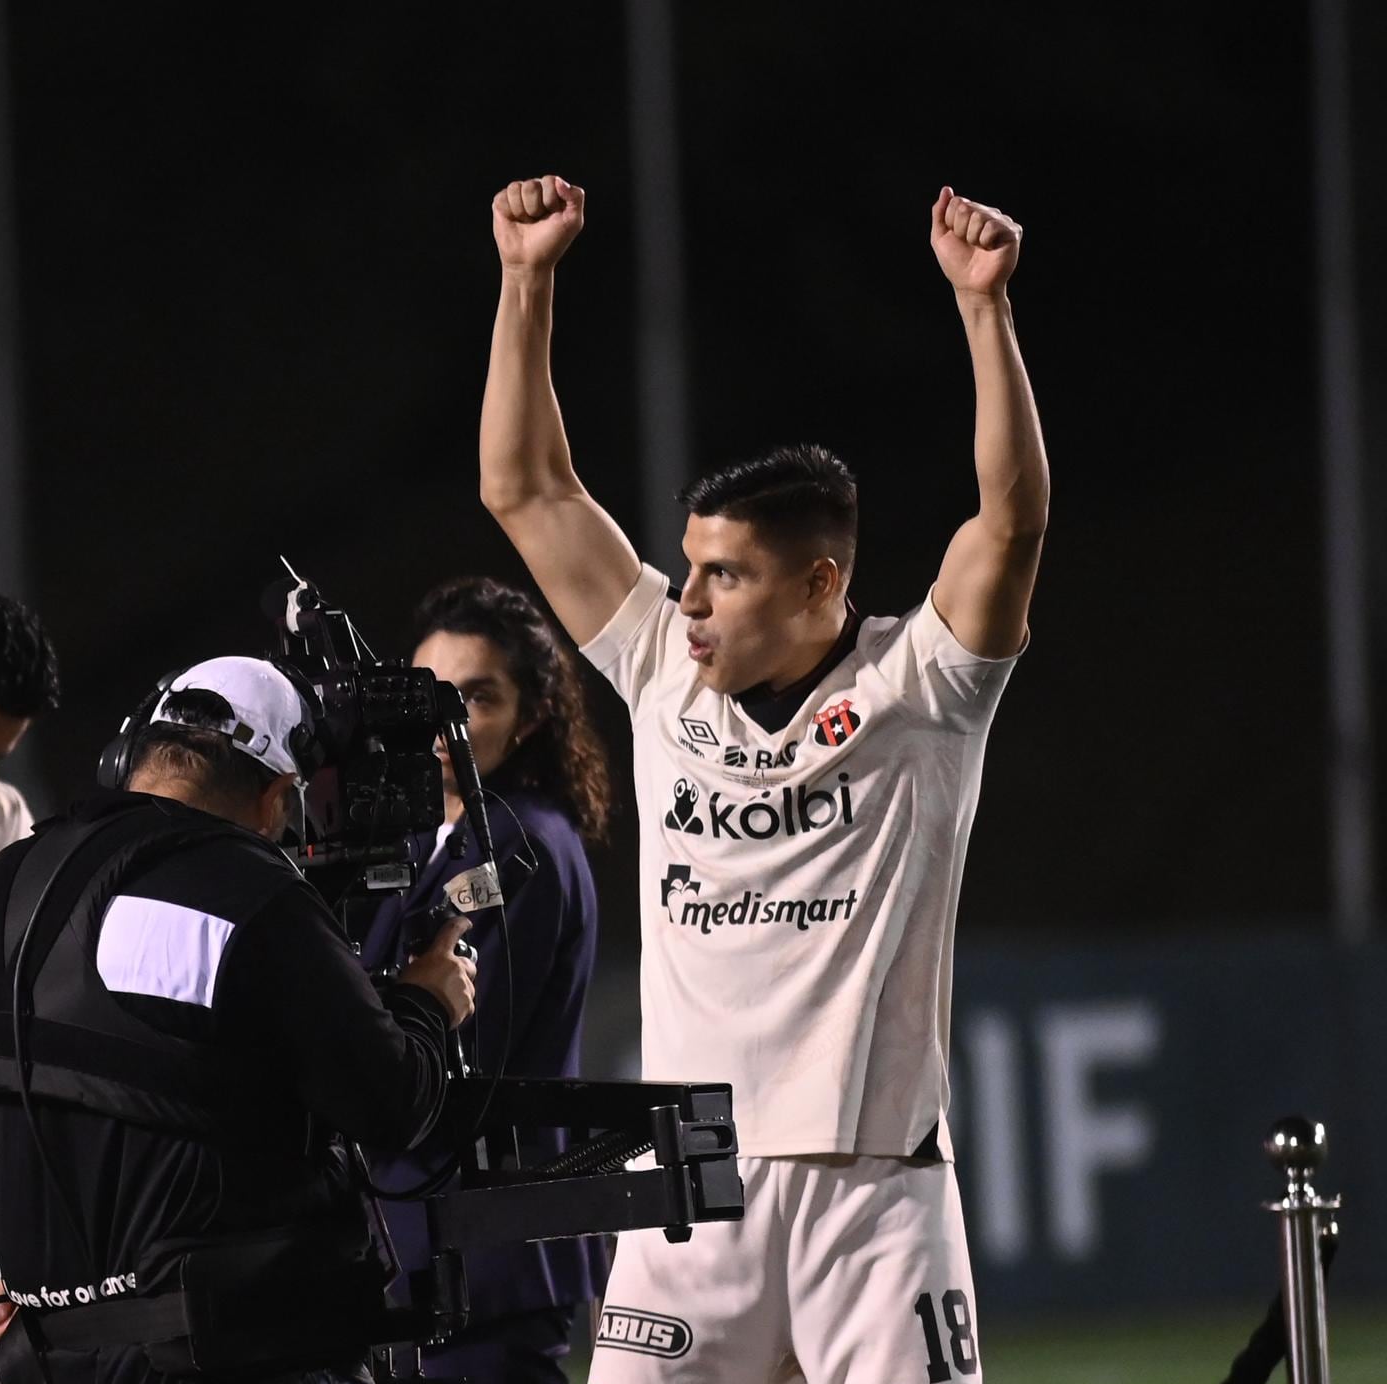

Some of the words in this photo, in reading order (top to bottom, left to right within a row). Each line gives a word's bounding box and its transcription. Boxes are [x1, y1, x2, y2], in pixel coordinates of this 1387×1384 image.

[818, 705, 845, 721] LDA
[680, 889, 858, 934] medismart
[40, 1286, 71, 1308] for
[597, 1314, 675, 1349] ABUS
[914, 1289, 977, 1384] 18
